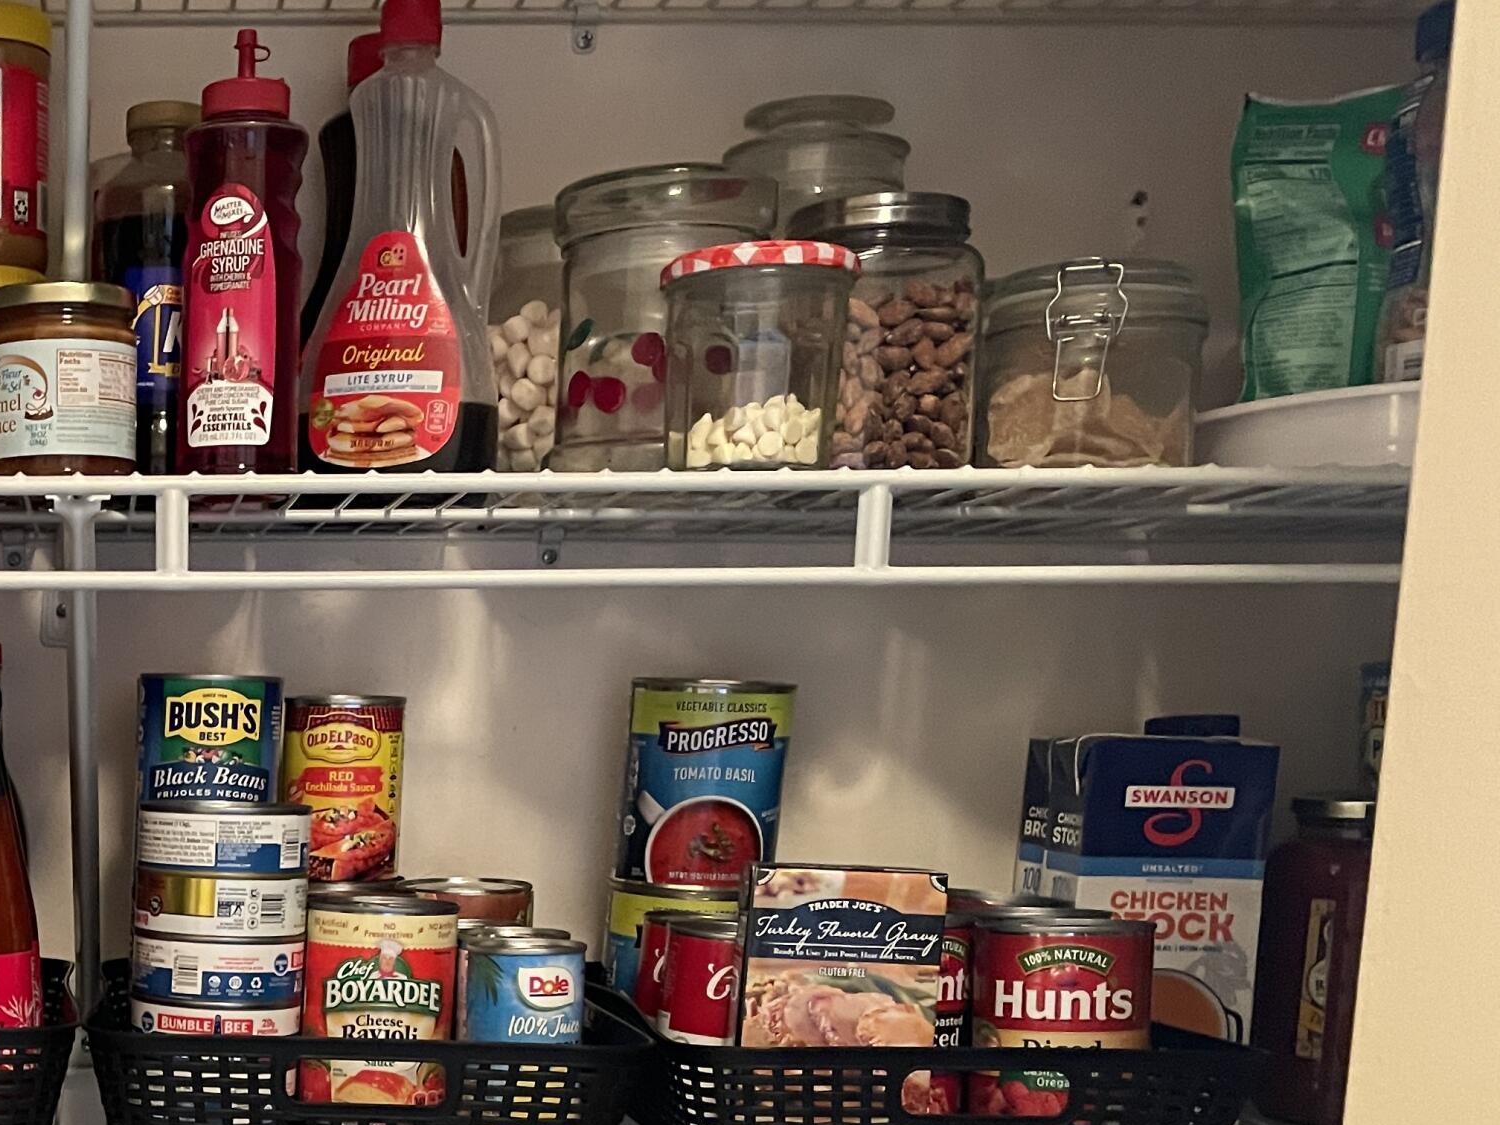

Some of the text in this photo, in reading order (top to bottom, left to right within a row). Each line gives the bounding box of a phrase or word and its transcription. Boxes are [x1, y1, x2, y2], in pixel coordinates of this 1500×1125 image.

[200, 239, 264, 259] GRENADINE
[211, 256, 250, 274] SYRUP
[356, 272, 422, 298] Pearl
[346, 298, 429, 329] Milling
[360, 322, 407, 332] COMPANY
[342, 342, 425, 370] Original
[347, 373, 414, 386] LITE SYRUP
[206, 413, 247, 422] COCKTAIL
[202, 422, 252, 432] ESSENTIALS
[676, 700, 768, 713] VEGETABLE CLASSICS
[168, 700, 258, 735] BUSH'S
[199, 731, 227, 742] BEST
[306, 733, 329, 748] OLD
[666, 720, 769, 752] PROGRESSO
[153, 765, 267, 791] Black Beans
[328, 770, 355, 782] RED
[673, 767, 756, 783] TOMATO BASIL
[305, 781, 376, 793] Enchilada Sauce
[156, 788, 260, 802] FRIJOLES NEGROS
[1130, 789, 1229, 804] SWANSON
[1141, 863, 1199, 873] UNSALTED
[808, 900, 884, 914] TRADER JOE'S
[1110, 890, 1229, 911] CHICKEN
[383, 922, 397, 931] NO
[1110, 912, 1235, 943] OCK
[364, 929, 414, 940] Preservatives
[755, 914, 940, 958] Turkey Flavored Gravy
[773, 947, 795, 957] Ready
[823, 950, 839, 958] Just
[1023, 948, 1109, 969] 100% NATURAL
[337, 959, 375, 981] Chef
[818, 966, 866, 978] GLUTEN FREE
[529, 975, 570, 995] Dole
[325, 979, 441, 1013] BOYARDEE
[994, 979, 1133, 1022] Hunts
[160, 1015, 249, 1035] BUMBLE BEE
[355, 1014, 404, 1028] Cheese
[508, 1013, 548, 1037] 100%
[934, 1015, 964, 1027] oasted
[933, 1028, 960, 1047] ced
[1036, 1077, 1070, 1088] Orega
